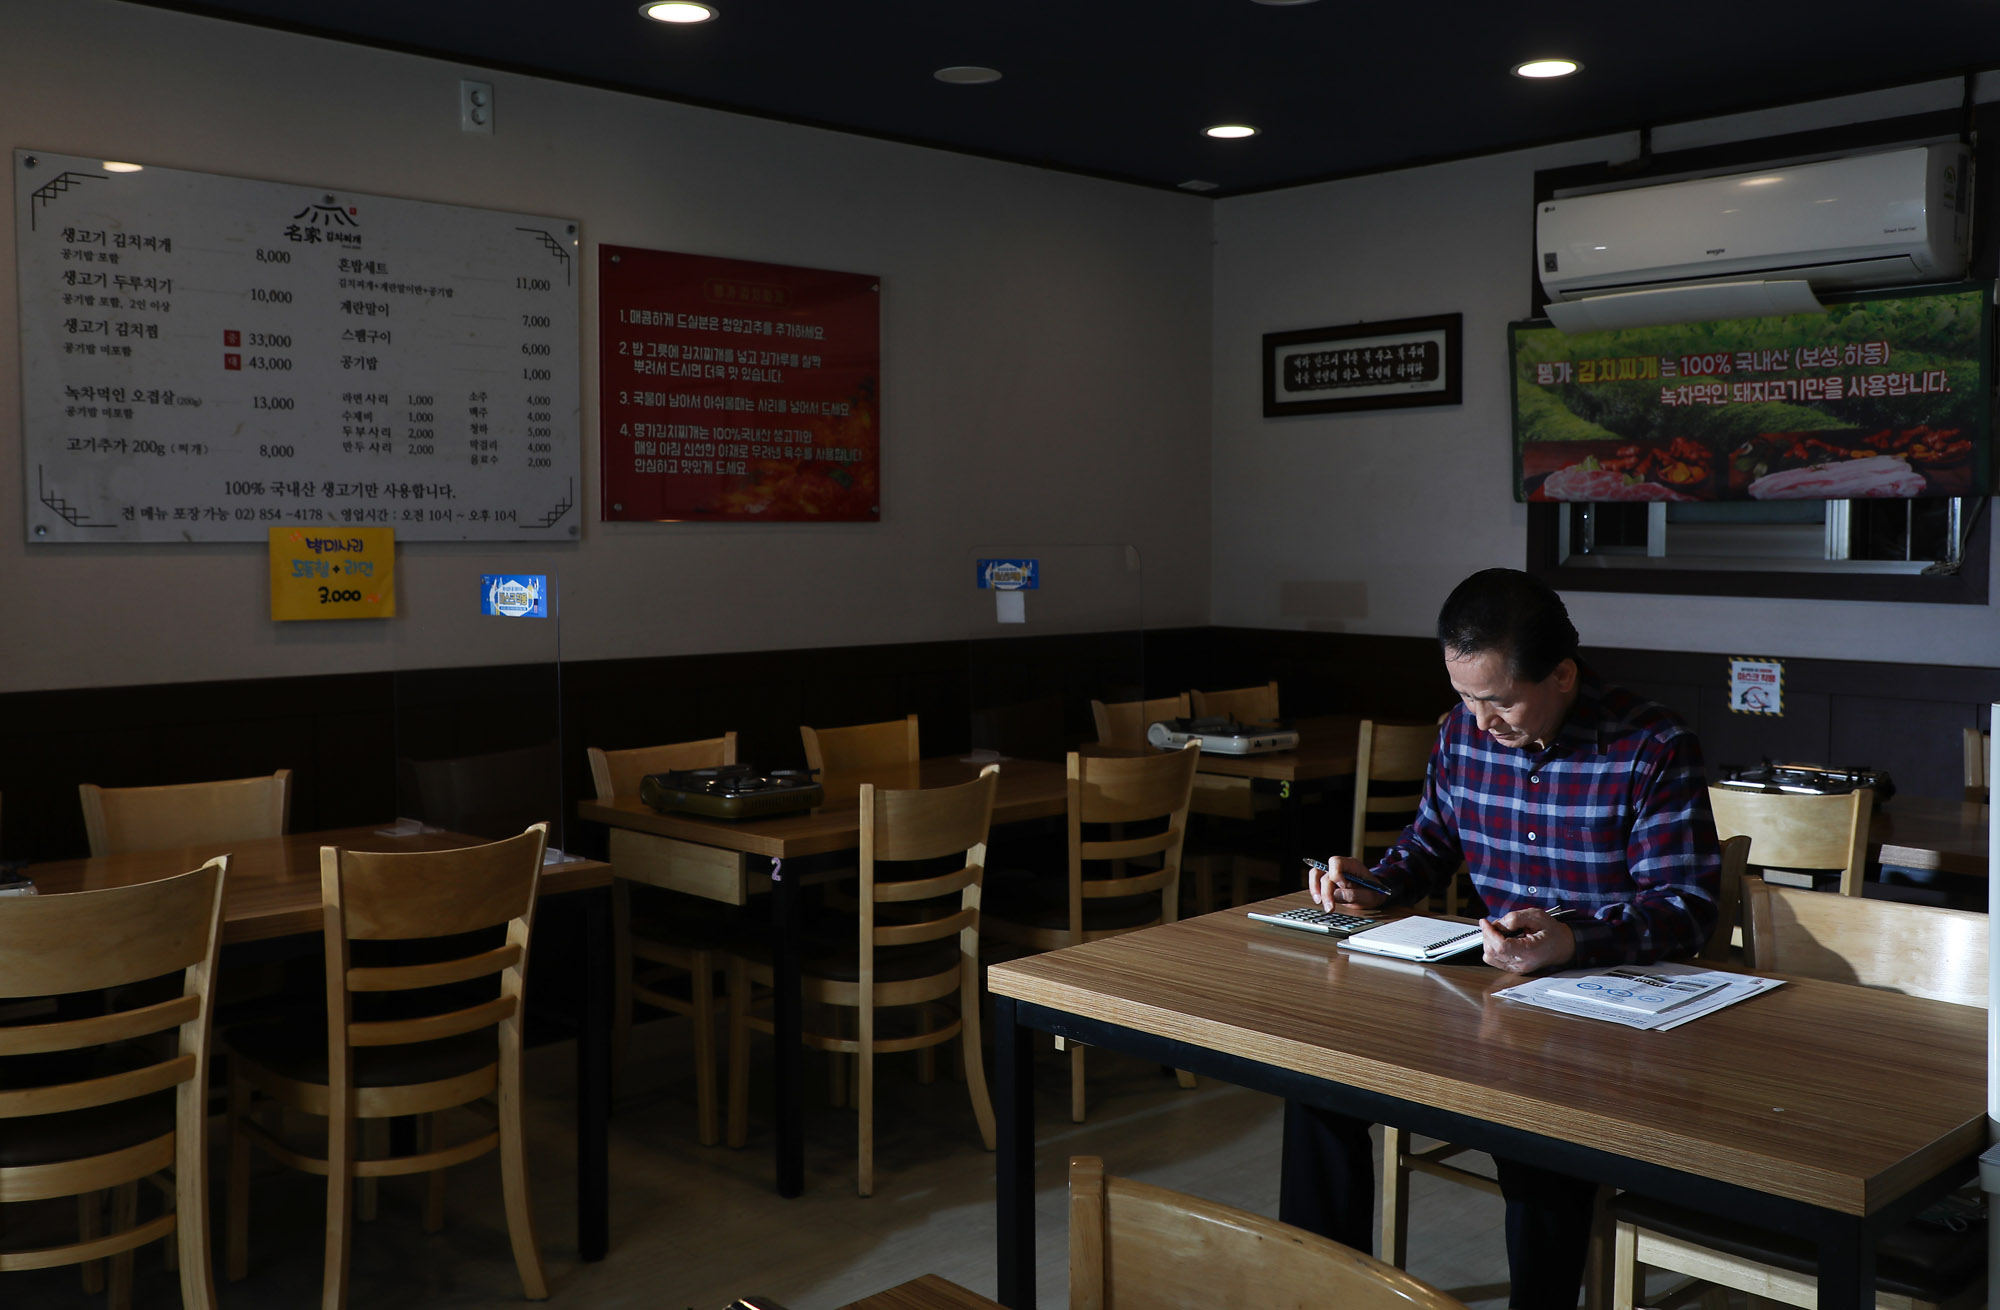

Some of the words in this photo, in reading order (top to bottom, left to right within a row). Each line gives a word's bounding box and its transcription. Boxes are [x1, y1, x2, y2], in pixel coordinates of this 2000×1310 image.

[61, 227, 107, 247] 생고기
[113, 233, 172, 253] 김치찌개
[284, 225, 322, 245] 名家
[61, 249, 94, 262] 공기밥
[98, 251, 120, 265] 포함
[255, 249, 291, 265] 8,000
[338, 258, 388, 275] 혼밥세트
[61, 270, 107, 289] 생고기
[113, 275, 172, 295] 두루치기
[515, 277, 550, 292] 11,000
[62, 293, 95, 307] 공기밥
[130, 298, 146, 311] 2인
[150, 300, 171, 314] 이상
[251, 288, 292, 305] 10,000
[340, 301, 390, 318] 계란말이
[63, 318, 109, 337] 생고기
[115, 322, 159, 339] 김치찜
[522, 315, 550, 329] 7,000
[619, 309, 628, 325] 1.
[630, 309, 674, 327] 매콤하게
[676, 313, 719, 332] 드실분은
[722, 317, 772, 336] 청양고추를
[248, 333, 292, 349] 33,000
[341, 329, 392, 346] 스팸구이
[63, 341, 96, 354] 공기밥
[100, 344, 132, 357] 미포함
[522, 343, 550, 357] 6,000
[618, 341, 630, 356] 2.
[632, 342, 644, 357] 밥
[647, 343, 679, 359] 그릇에
[682, 345, 734, 363] 김치찌개를
[736, 349, 757, 365] 넣고
[760, 350, 799, 367] 김가루를
[802, 354, 822, 369] 살짝
[248, 356, 292, 371] 43,000
[340, 355, 378, 371] 공기밥
[634, 360, 667, 376] 뿌려서
[669, 361, 701, 378] 드시면
[704, 363, 725, 379] 더욱
[1537, 361, 1574, 385] 명가
[1578, 355, 1658, 385] 김치찌개
[1682, 355, 1732, 374] 100%
[1735, 350, 1789, 374] 국내산
[1795, 341, 1890, 370] (보성,하동)
[522, 368, 550, 382] 1,000
[64, 385, 126, 403] 녹차먹인
[131, 389, 175, 406] 오겹살
[1660, 383, 1729, 407] 녹차먹인
[1733, 377, 1844, 403] 돼지고기만을
[1847, 370, 1952, 399] 사용합니다.
[253, 397, 294, 411] 13,000
[408, 395, 434, 407] 1,000
[468, 392, 488, 403] 소주
[527, 395, 551, 407] 4,000
[619, 391, 630, 406] 3.
[633, 392, 666, 407] 국물이
[668, 394, 701, 409] 남아서
[758, 398, 787, 414] 사리를
[790, 400, 819, 415] 넣어서
[65, 406, 98, 418] 공기밥
[101, 408, 134, 420] 미포함
[342, 411, 374, 423] 수제비
[408, 411, 434, 423] 1,000
[468, 407, 489, 419] 맥주
[527, 412, 551, 424] 4,000
[408, 428, 434, 440] 2,000
[469, 423, 489, 436] 청하
[527, 427, 551, 439] 5,000
[619, 423, 632, 438] 4.
[634, 423, 709, 441] 명가김치찌개는
[773, 429, 812, 444] 생고기와
[66, 438, 127, 454] 고기추가
[132, 439, 166, 456] 200g
[259, 444, 294, 459] 8,000
[408, 444, 435, 456] 2,000
[469, 439, 498, 452] 막걸리
[527, 442, 551, 454] 4,000
[634, 440, 656, 456] 매일
[659, 441, 681, 456] 아침
[684, 442, 715, 458] 신선한
[718, 443, 749, 459] 야채로
[751, 445, 782, 460] 우려낸
[785, 446, 813, 461] 육수를
[470, 455, 499, 467] 음료수
[527, 457, 552, 469] 2,000
[634, 458, 678, 474] 안심하고
[681, 459, 713, 475] 맛있게
[224, 481, 265, 496] 100%
[270, 481, 316, 498] 국내산
[321, 482, 378, 499] 생고기만
[384, 484, 457, 500] 사용합니다.
[122, 506, 136, 522] 전
[140, 507, 168, 522] 메뉴
[235, 508, 255, 521] 02)
[259, 508, 281, 521] 854
[340, 508, 388, 523] 영업시간
[401, 508, 424, 523] 오전
[429, 508, 453, 523] 10시
[467, 508, 490, 522] 오후
[495, 508, 517, 522] 10시
[305, 538, 364, 555] 별미사리
[344, 559, 375, 578] 라면
[318, 586, 362, 604] 3.000
[1737, 672, 1760, 681] 마스크
[1761, 674, 1776, 682] 착용
[1280, 780, 1290, 798] 3
[770, 857, 782, 881] 2
